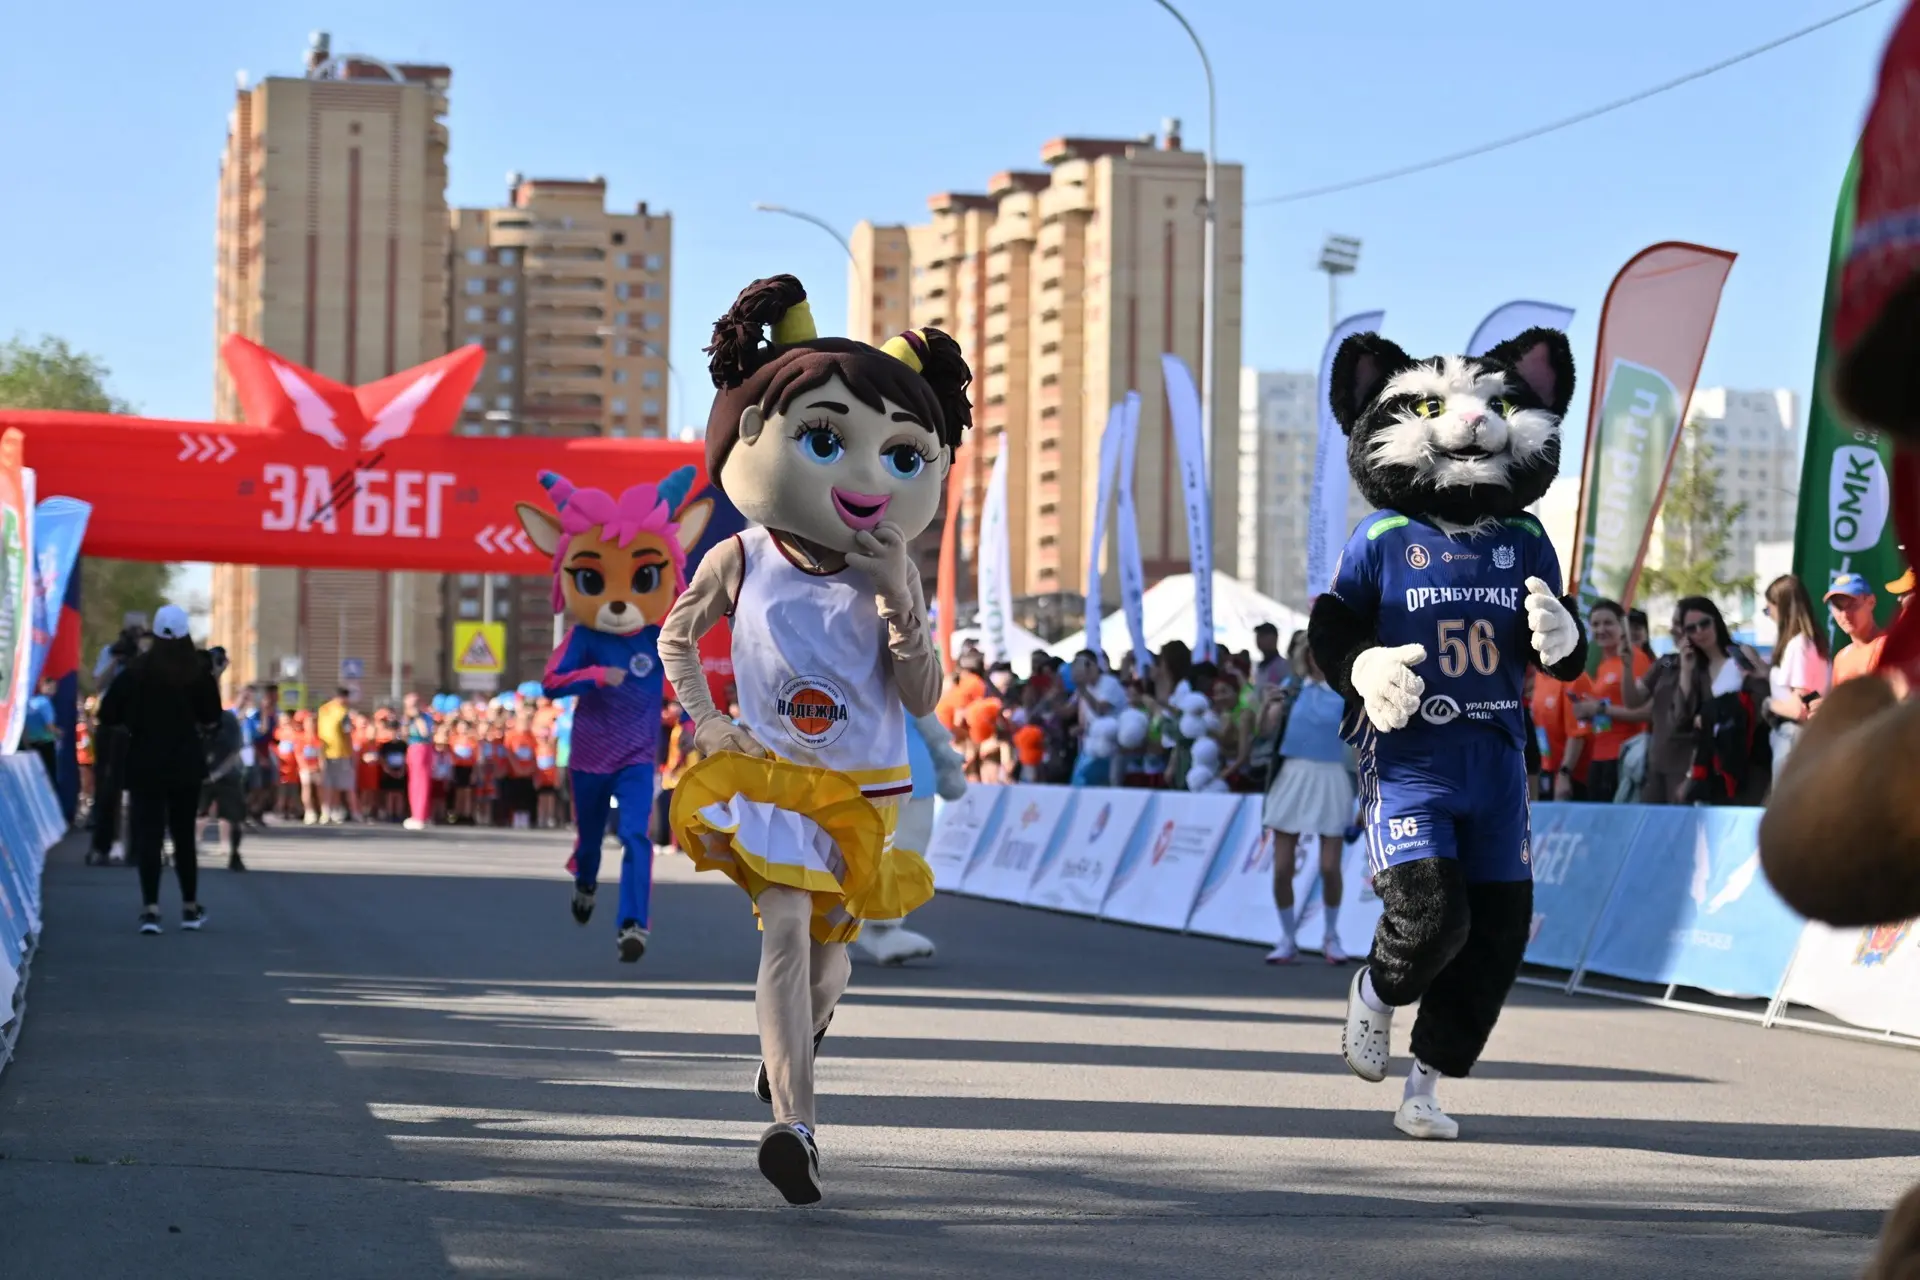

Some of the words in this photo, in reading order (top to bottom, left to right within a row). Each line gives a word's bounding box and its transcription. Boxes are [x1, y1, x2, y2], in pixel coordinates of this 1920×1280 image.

[1834, 453, 1875, 543] ОМК
[1406, 587, 1519, 612] ОРЕНБУРЖЬЕ
[1437, 618, 1500, 678] 56
[777, 698, 848, 722] НАДЕЖДА
[1465, 700, 1518, 711] УРАЛЬСКАЯ
[1388, 816, 1419, 840] 56
[1396, 840, 1429, 850] СПОРТАРТ
